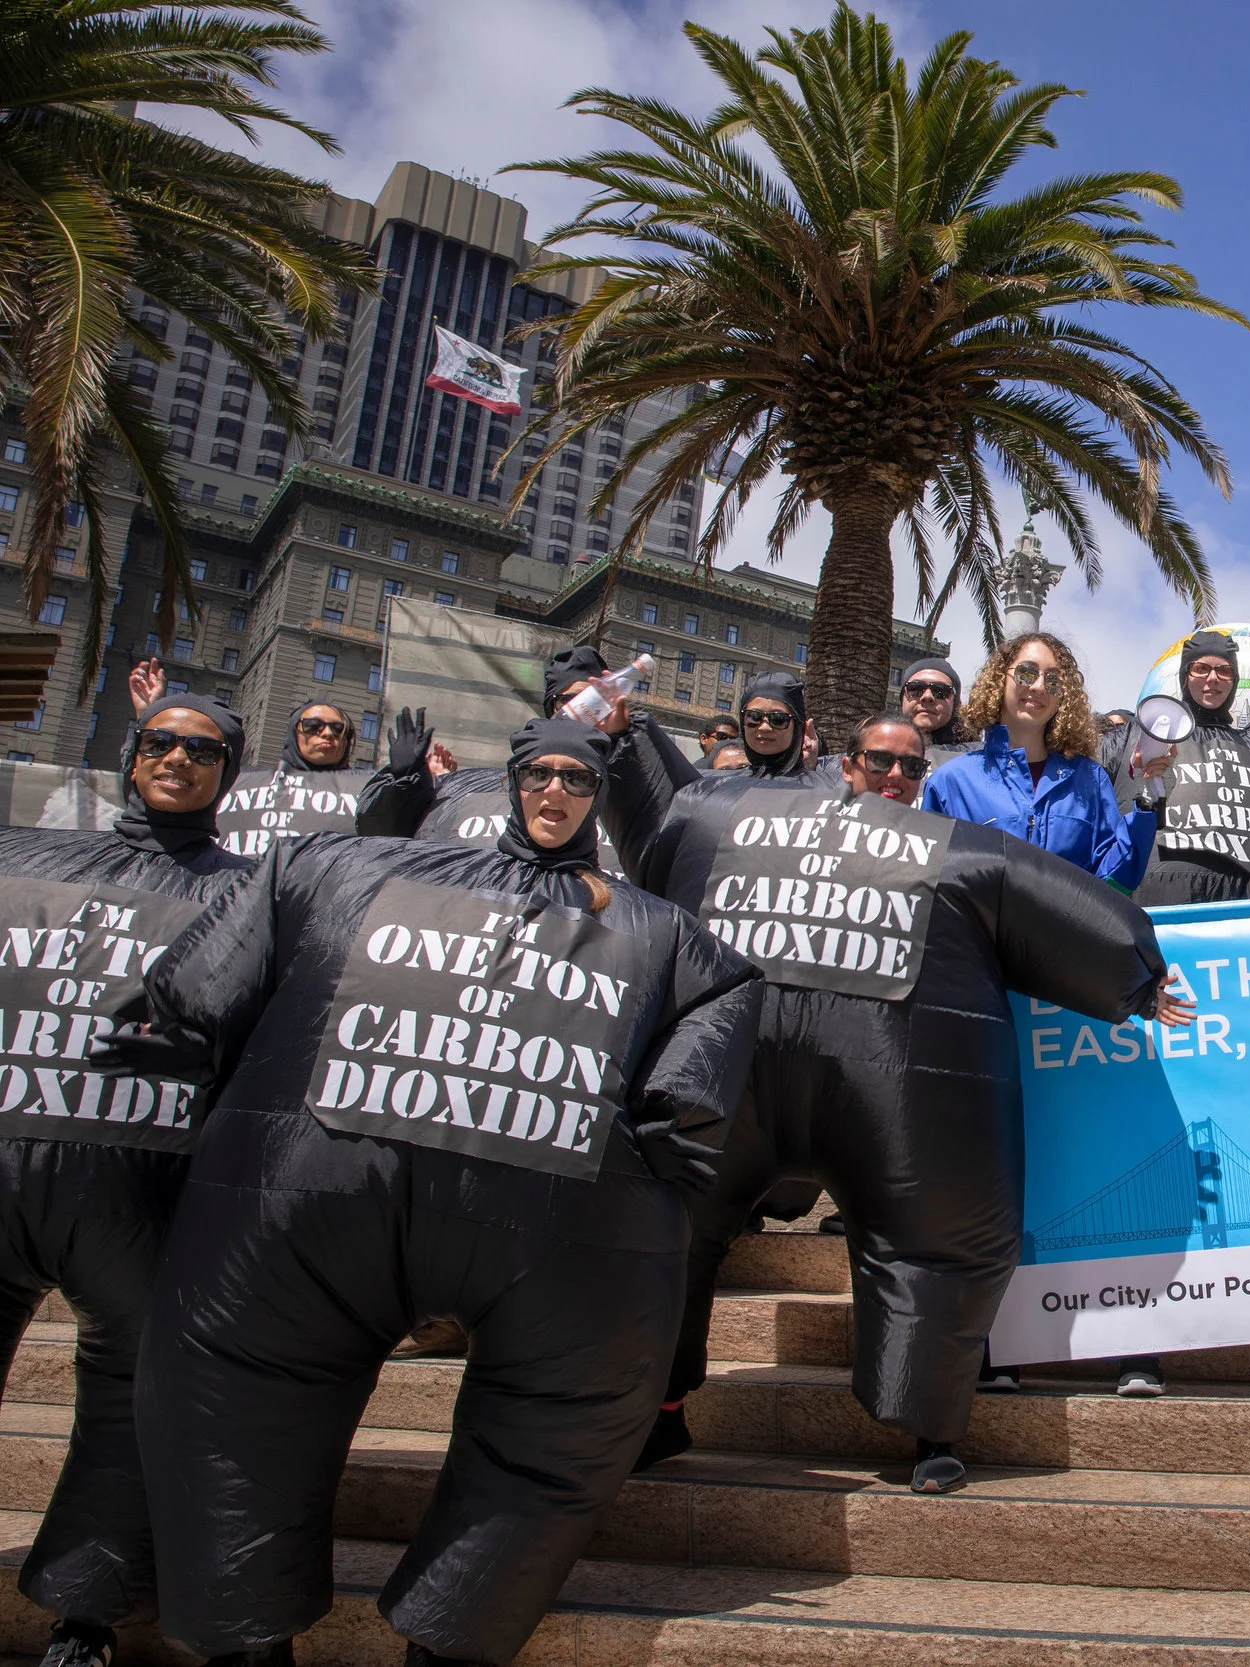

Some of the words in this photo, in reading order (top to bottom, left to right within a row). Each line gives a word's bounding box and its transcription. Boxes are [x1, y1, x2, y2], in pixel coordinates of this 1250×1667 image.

[1173, 762, 1226, 784] NE
[288, 787, 359, 817] TON
[1217, 787, 1245, 803] OF
[260, 811, 294, 828] OF
[458, 815, 512, 839] ON
[733, 816, 828, 849] ONE
[838, 819, 938, 866] TON
[799, 853, 842, 878] OF
[714, 875, 922, 933] CARBON
[0, 928, 86, 971] NE
[708, 918, 912, 979] DIOXIDE
[366, 924, 498, 979] ONE
[511, 947, 629, 1018] TON
[47, 977, 107, 1008] OF
[458, 985, 516, 1018] OF
[337, 1003, 612, 1096] CARBON
[1031, 1013, 1247, 1070] EASIER,
[0, 1064, 196, 1130] OXIDE
[316, 1059, 600, 1154] DIOXIDE
[1041, 1289, 1090, 1313] Our
[1098, 1283, 1159, 1309] City,
[1166, 1279, 1216, 1302] Our
